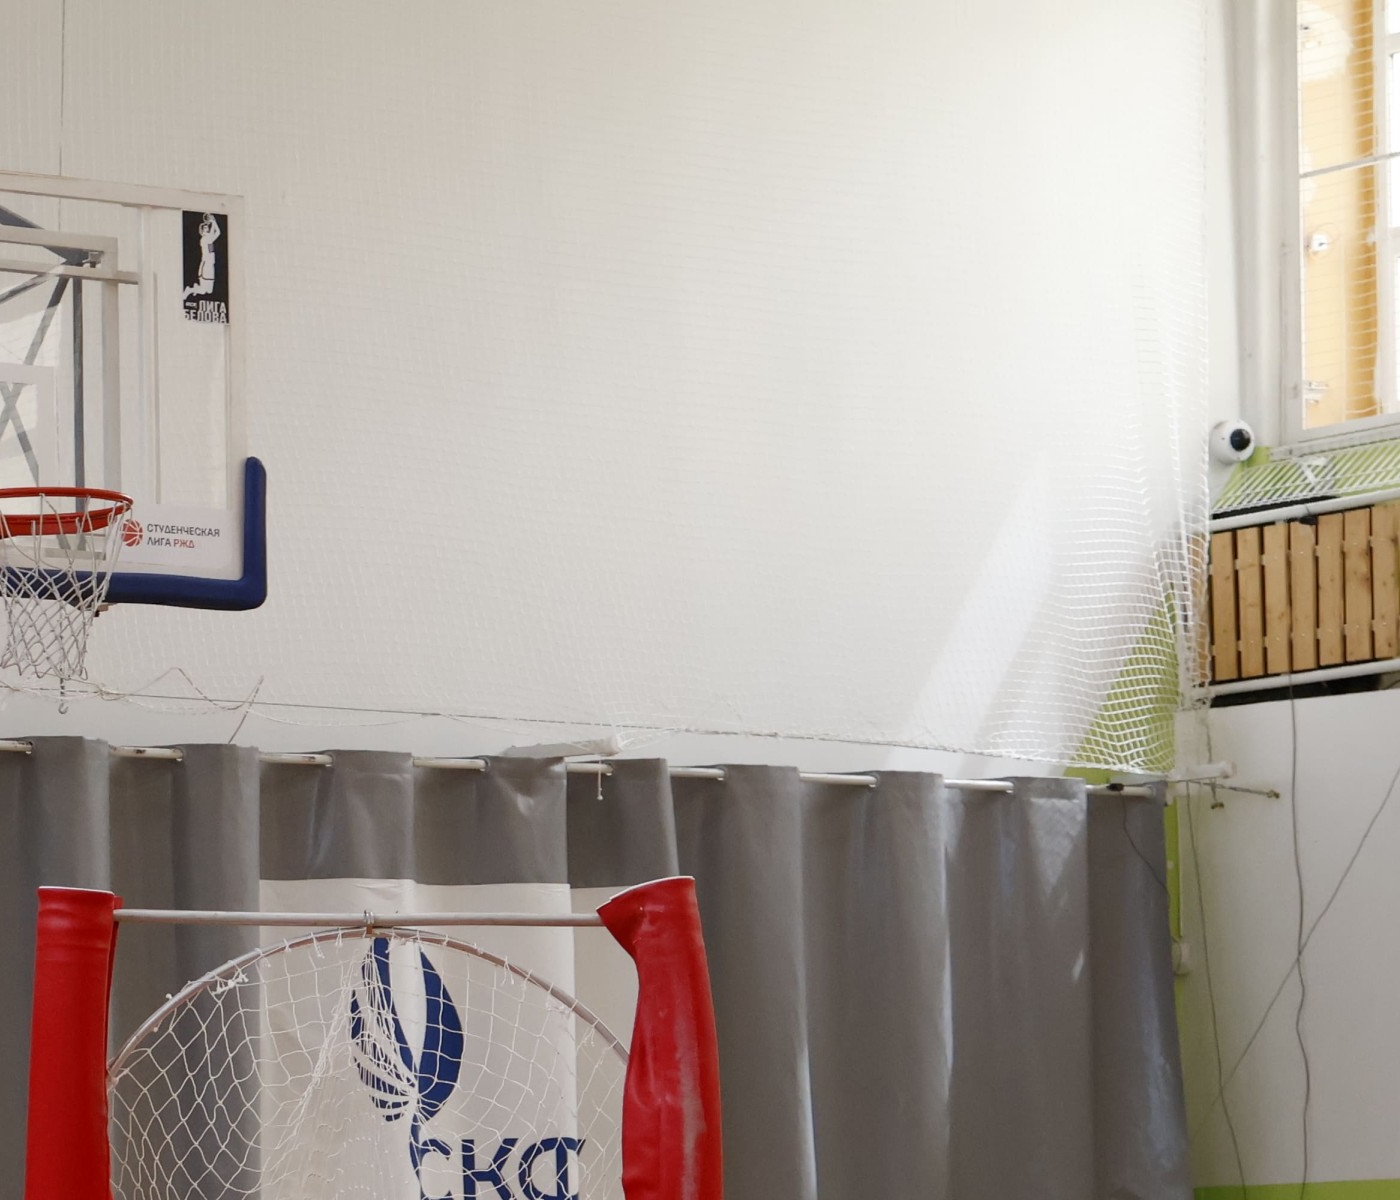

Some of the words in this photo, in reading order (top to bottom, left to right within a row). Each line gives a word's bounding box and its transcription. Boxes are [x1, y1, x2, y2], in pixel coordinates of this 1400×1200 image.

[199, 300, 227, 314] ЛИГА
[146, 523, 220, 537] СТУДЕНЧЕСКАЯ
[147, 536, 172, 547] ЛИГА
[173, 538, 195, 549] РЖД
